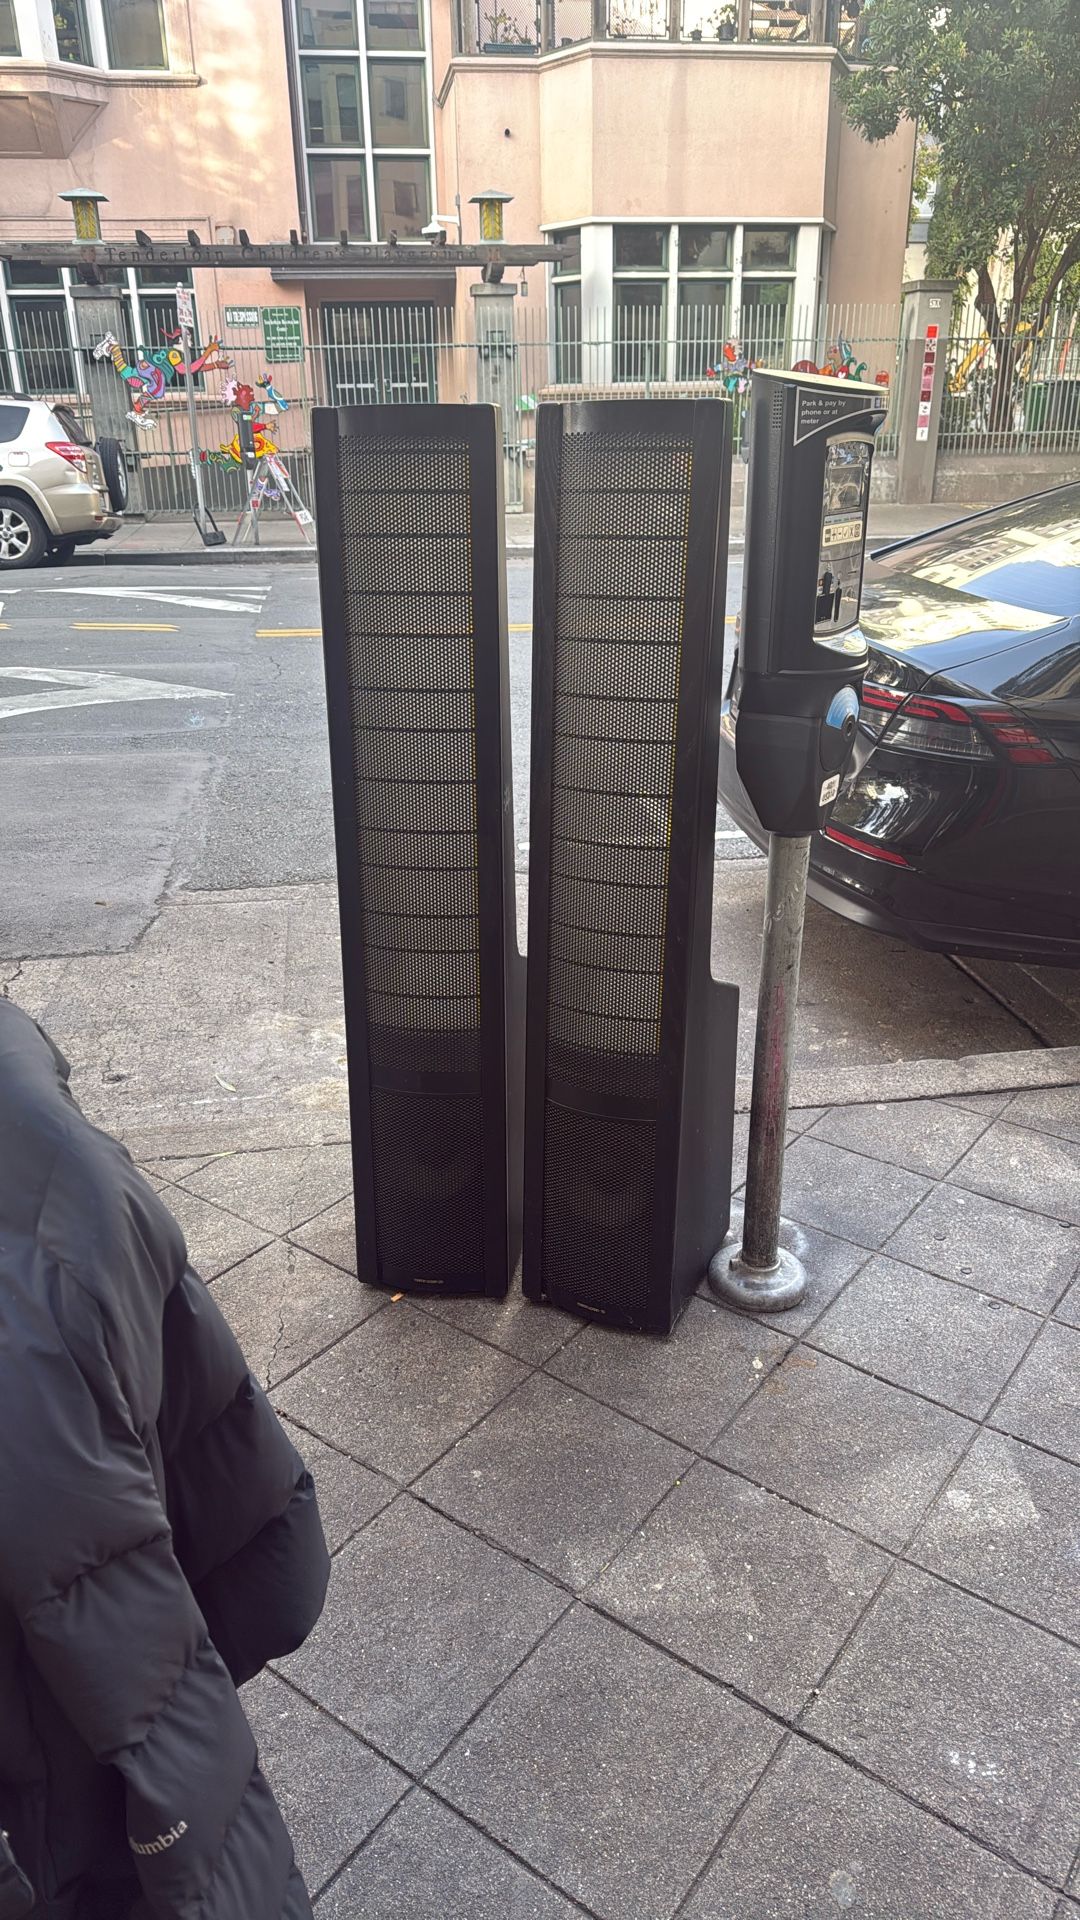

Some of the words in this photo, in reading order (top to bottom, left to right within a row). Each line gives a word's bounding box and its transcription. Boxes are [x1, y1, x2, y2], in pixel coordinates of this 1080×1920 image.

[104, 246, 225, 263] Tenderloin
[241, 245, 346, 262] Children's
[129, 1820, 188, 1855] lumbia
